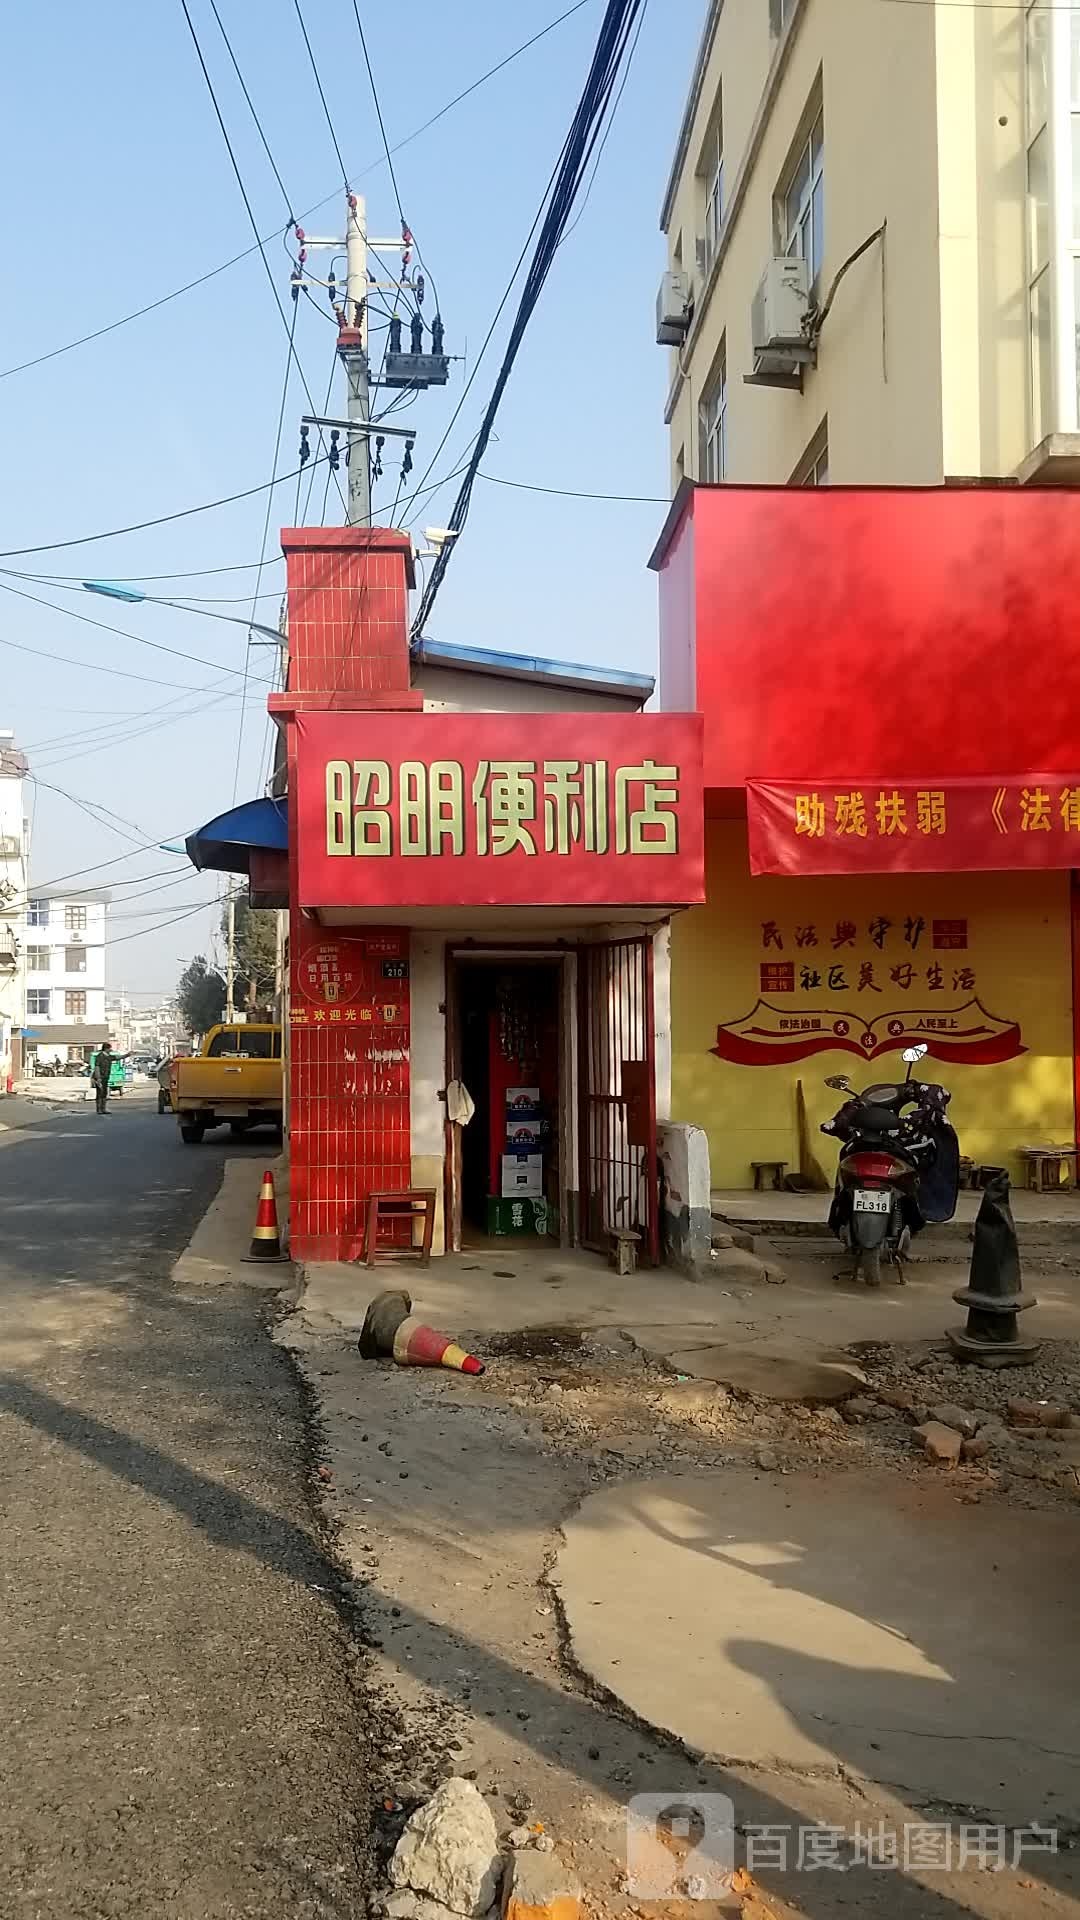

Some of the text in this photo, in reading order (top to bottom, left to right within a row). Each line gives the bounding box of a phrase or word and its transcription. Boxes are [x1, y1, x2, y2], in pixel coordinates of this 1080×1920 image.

[325, 760, 679, 856] 昭明便利店
[795, 790, 947, 837] 助残扶弱
[761, 917, 926, 950] 民法典守护
[310, 973, 352, 982] 日用百货
[800, 961, 976, 992] 社区美好生活
[314, 1009, 372, 1021] 欢迎光临
[779, 1019, 821, 1029] 依法治国
[916, 1019, 958, 1029] 人民至上
[856, 1200, 887, 1211] FL318
